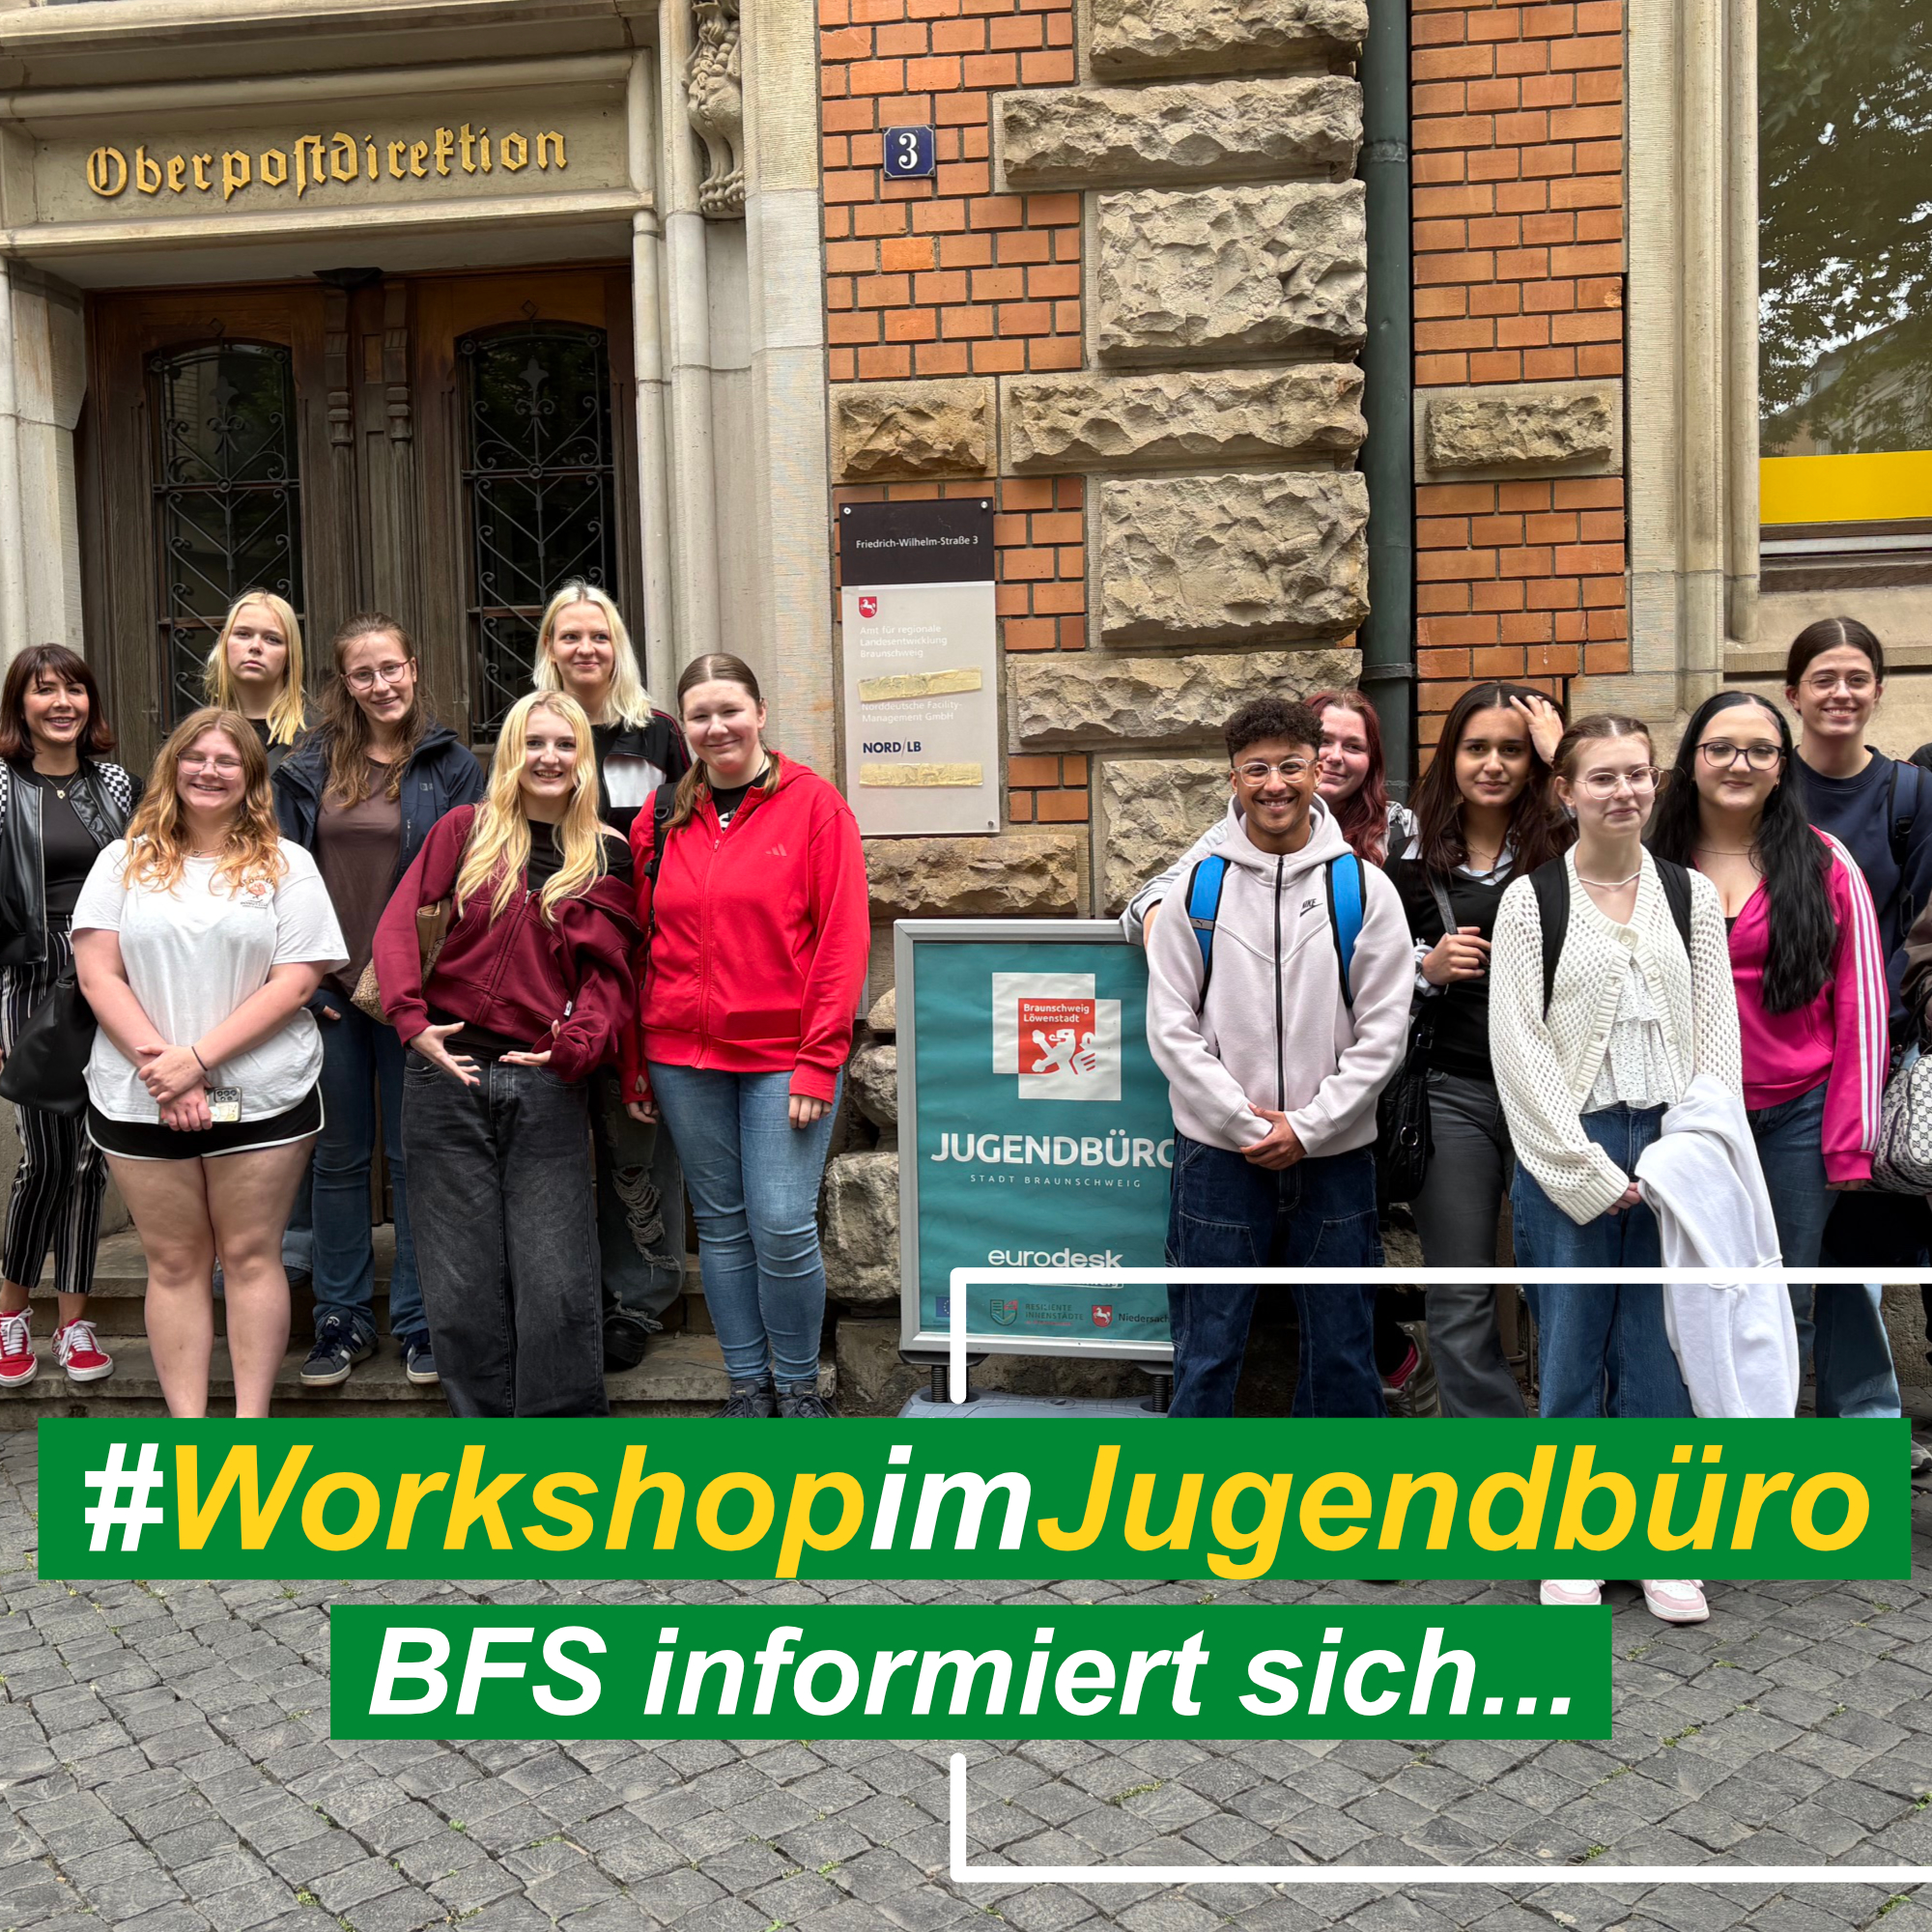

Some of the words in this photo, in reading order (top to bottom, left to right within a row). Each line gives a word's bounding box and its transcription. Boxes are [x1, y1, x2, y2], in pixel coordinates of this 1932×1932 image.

[898, 132, 918, 169] 3
[856, 535, 970, 549] Friedrich-Wilhelm-Straße
[972, 535, 979, 545] 3
[860, 626, 878, 635] Amt
[897, 624, 941, 635] regionale
[860, 637, 948, 646] Landesentwicklung
[860, 648, 923, 658] Braunschweig
[862, 702, 924, 711] Norddeutsche
[927, 700, 962, 710] Facility-
[862, 714, 923, 724] Management
[925, 712, 953, 721] GmbH
[863, 737, 922, 757] NORD/LB
[1023, 1004, 1090, 1014] Braunschweig
[1023, 1013, 1080, 1023] Löwenstadt
[970, 1174, 1015, 1183] STADT
[1024, 1176, 1141, 1188] BRAUNSCHWEIG
[987, 1248, 1123, 1267] eurodesk
[1025, 1310, 1084, 1321] INNENSTÄDTE
